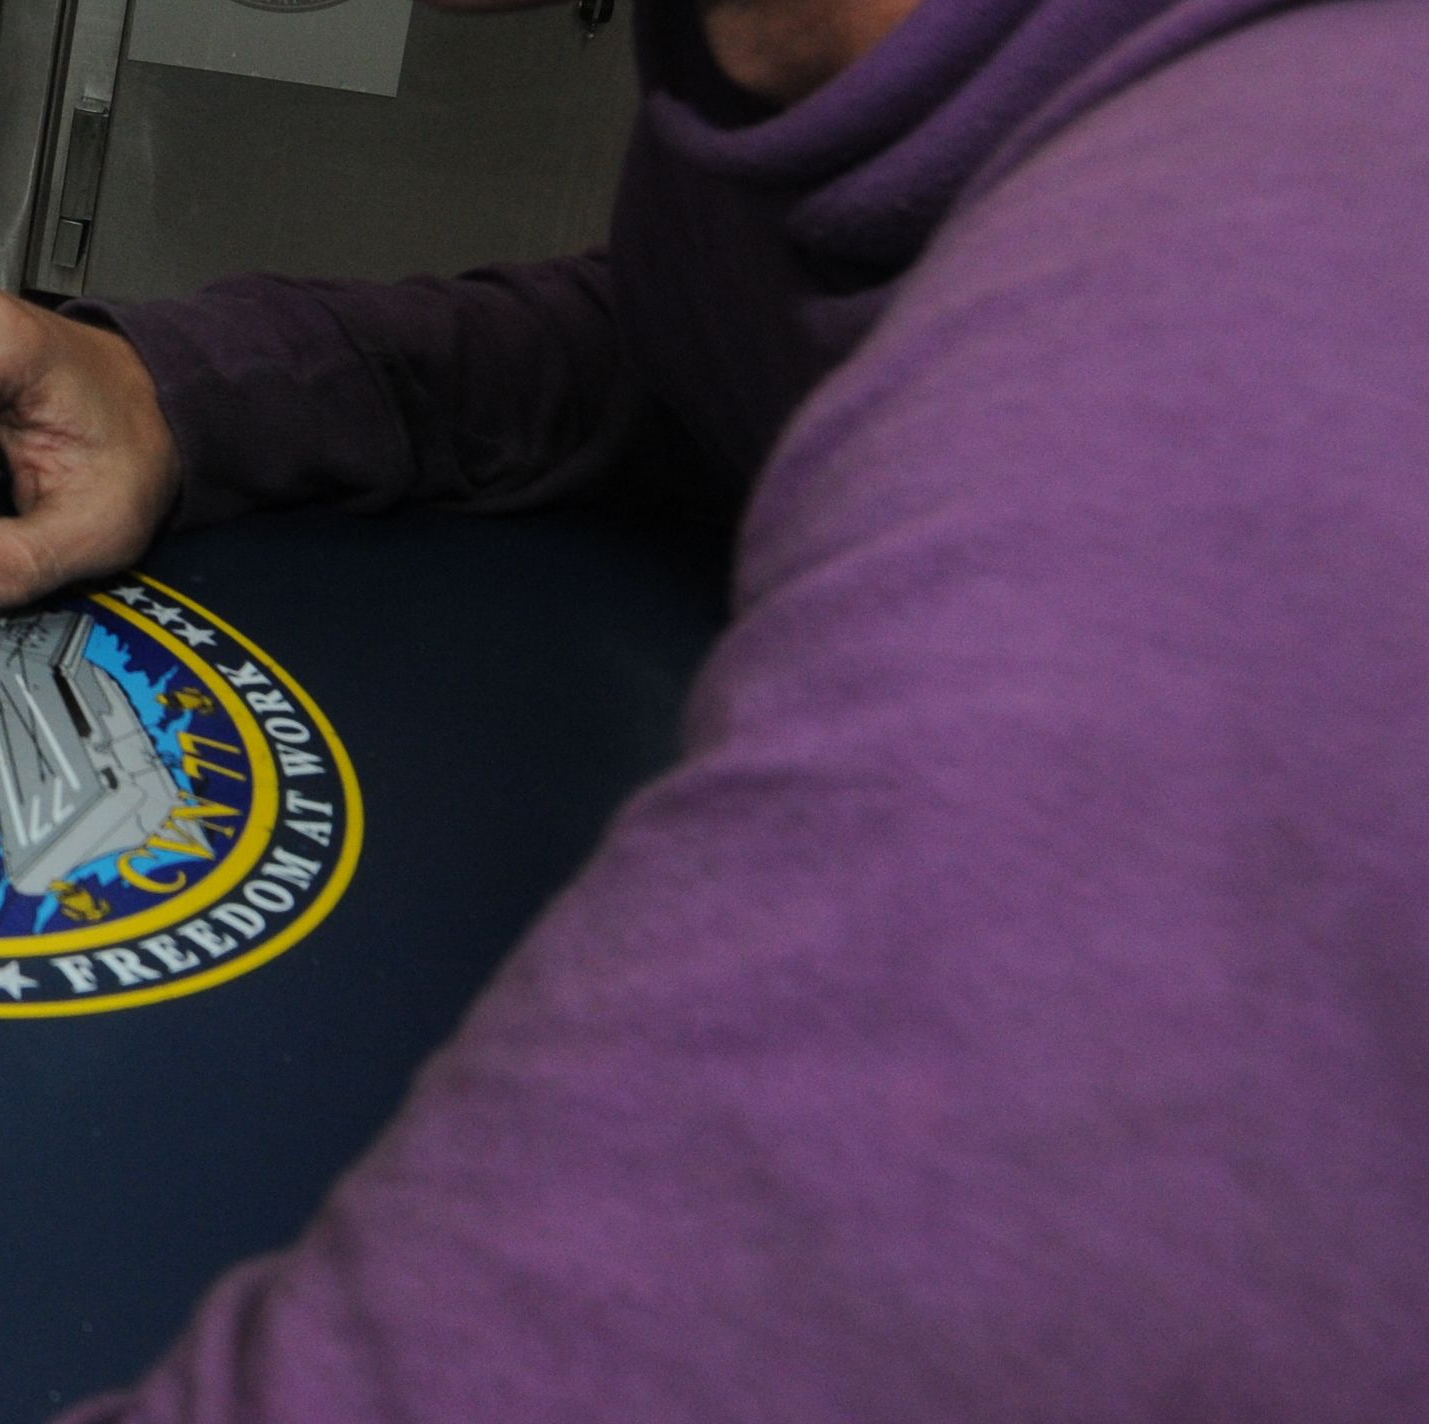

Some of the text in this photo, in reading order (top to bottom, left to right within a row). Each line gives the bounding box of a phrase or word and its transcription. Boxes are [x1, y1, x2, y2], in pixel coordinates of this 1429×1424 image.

[48, 659, 334, 995] FREEDOM AT WORK
[116, 729, 247, 894] CVN 77
